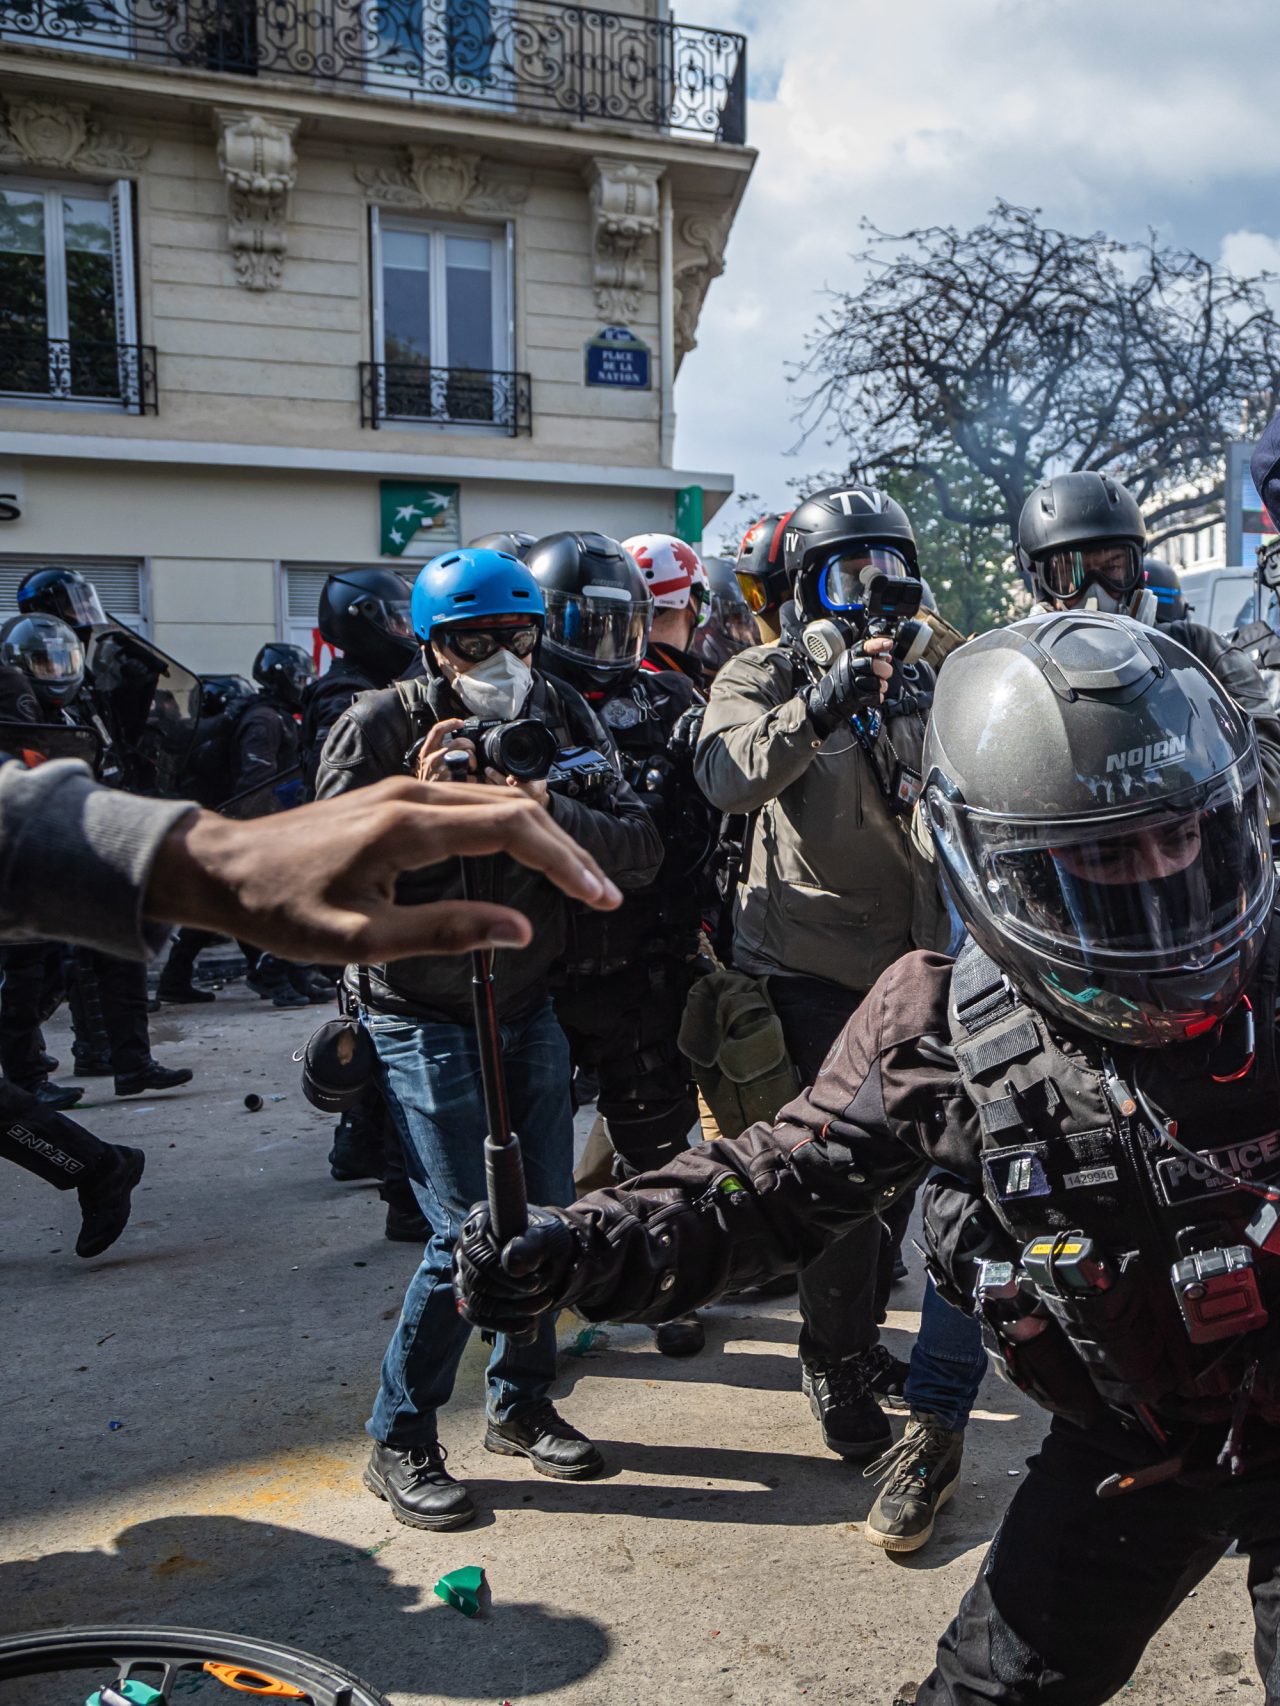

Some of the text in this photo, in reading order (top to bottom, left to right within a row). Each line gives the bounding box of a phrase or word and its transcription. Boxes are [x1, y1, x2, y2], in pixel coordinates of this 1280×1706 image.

[602, 350, 633, 361] PLACE
[602, 361, 633, 372] DE LA
[598, 370, 640, 383] NATION
[829, 490, 882, 516] TV
[785, 532, 799, 552] TV
[1105, 734, 1187, 772] NOLAN
[6, 1123, 86, 1175] BERING
[1067, 1169, 1115, 1186] 1429946
